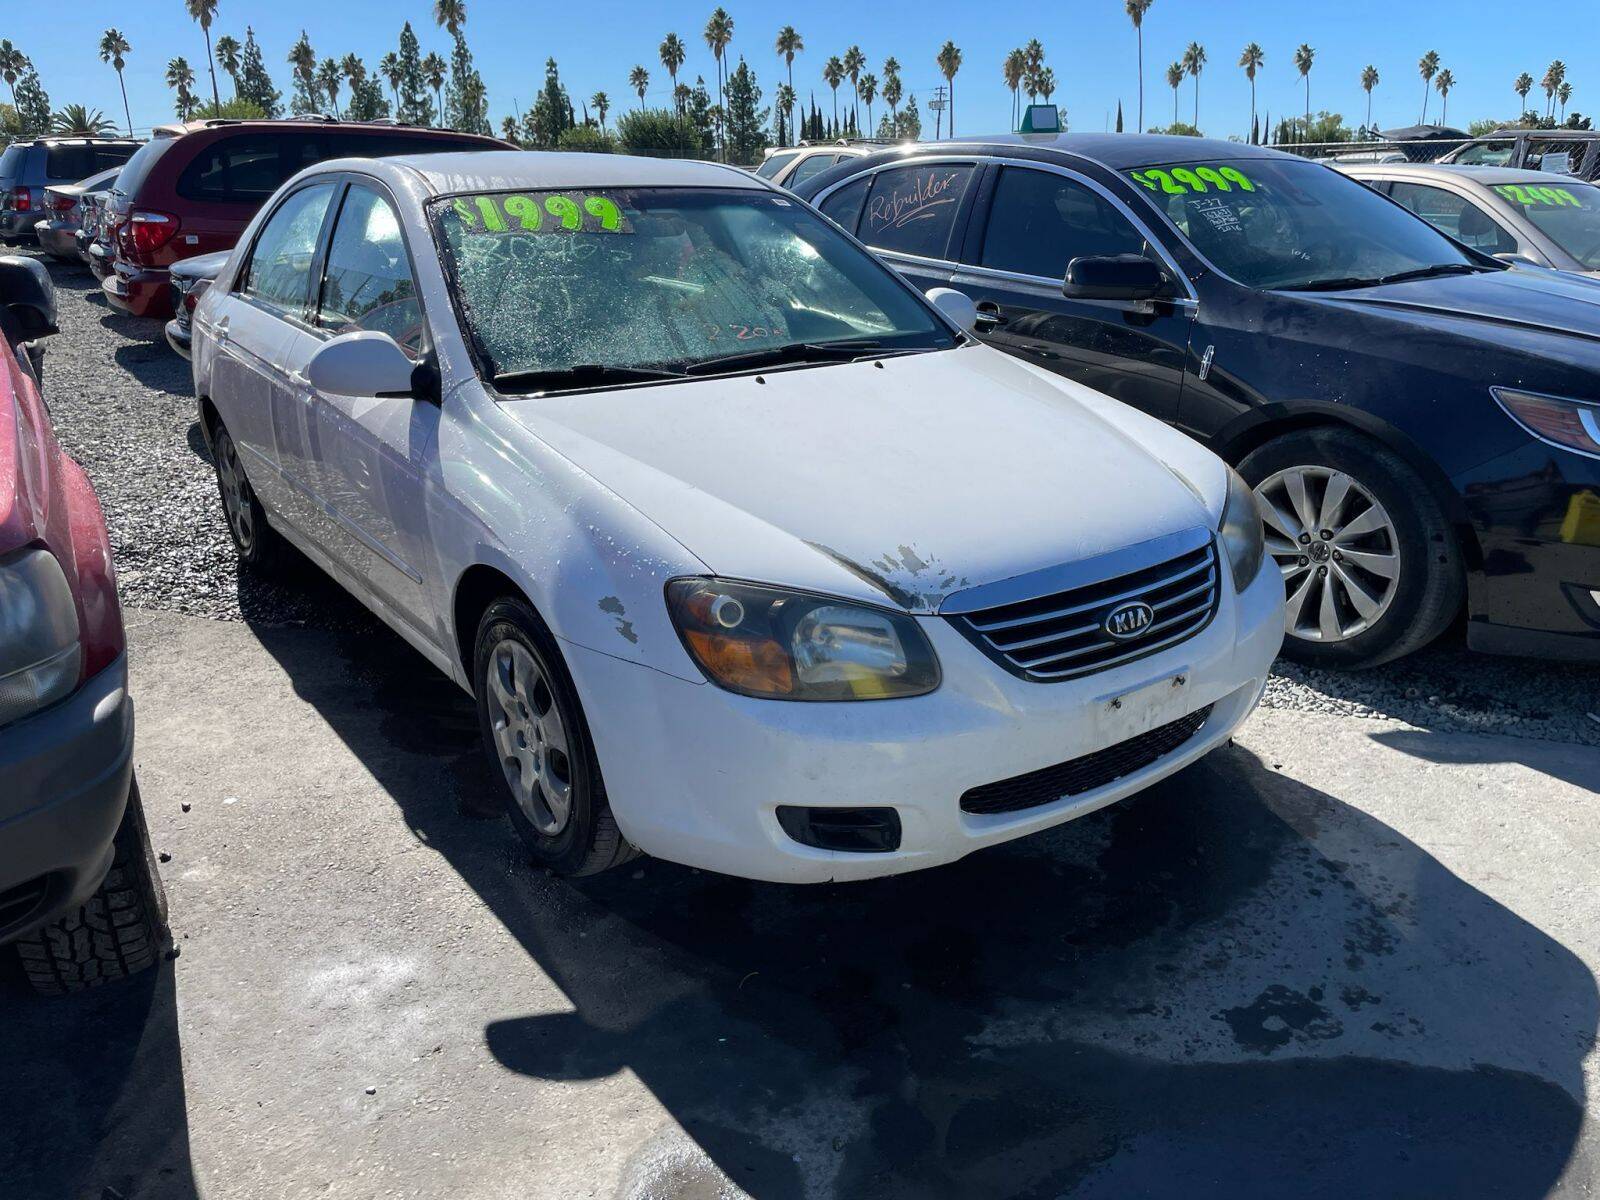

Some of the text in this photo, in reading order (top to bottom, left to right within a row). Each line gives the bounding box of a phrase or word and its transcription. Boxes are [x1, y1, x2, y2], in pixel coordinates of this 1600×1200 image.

[1130, 166, 1255, 194] $2999
[453, 196, 624, 232] $1999
[870, 173, 959, 228] Rebuilder
[1114, 608, 1148, 632] KIA
